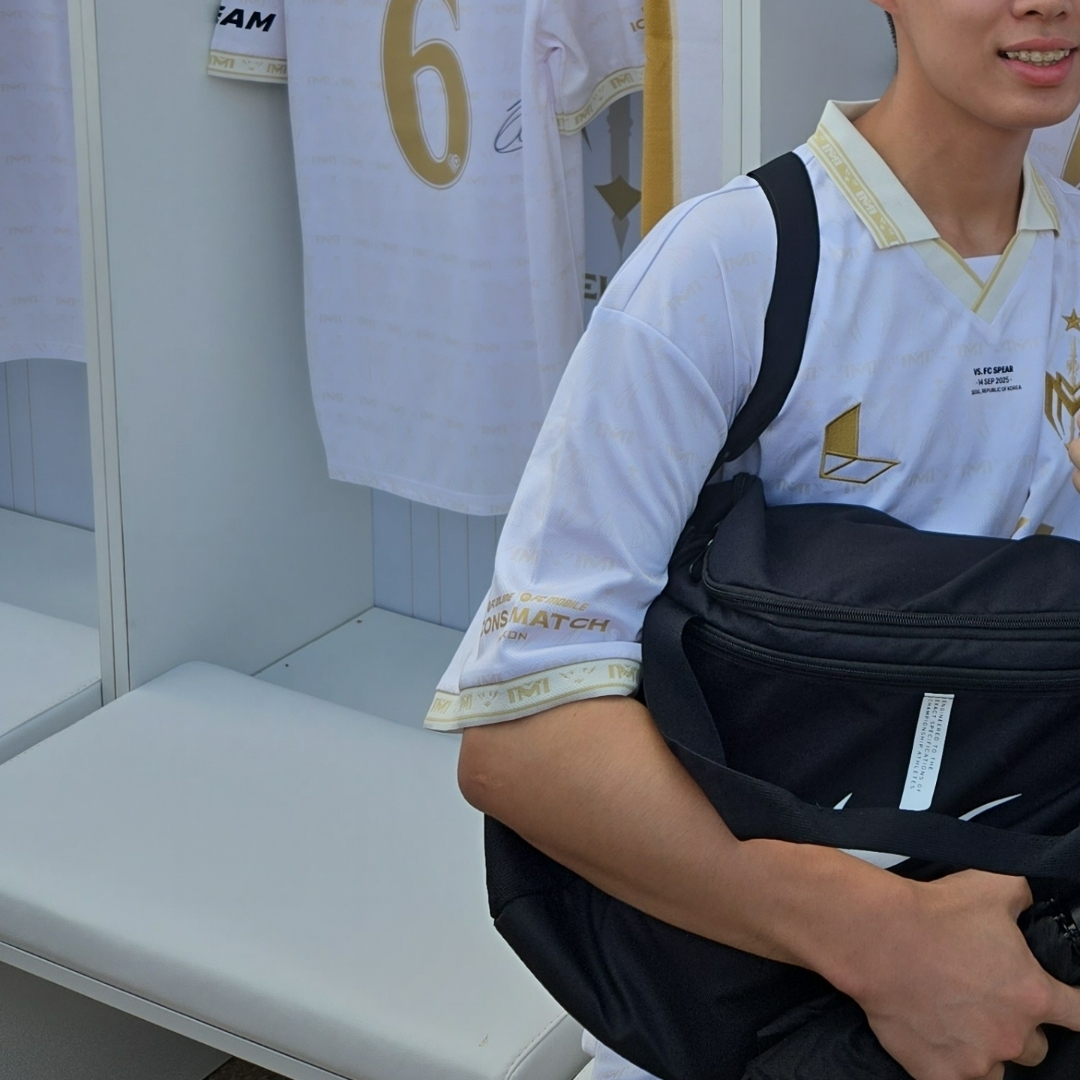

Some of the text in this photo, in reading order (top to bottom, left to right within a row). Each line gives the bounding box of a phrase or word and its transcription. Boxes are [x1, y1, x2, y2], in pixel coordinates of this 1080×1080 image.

[983, 366, 992, 375] FC
[993, 365, 1014, 374] SPEAR
[984, 377, 995, 385] SEP
[510, 606, 611, 632] MATCH
[918, 721, 935, 781] SPECIFICATIONS
[909, 750, 922, 789] ATHLETES
[927, 757, 936, 770] THE
